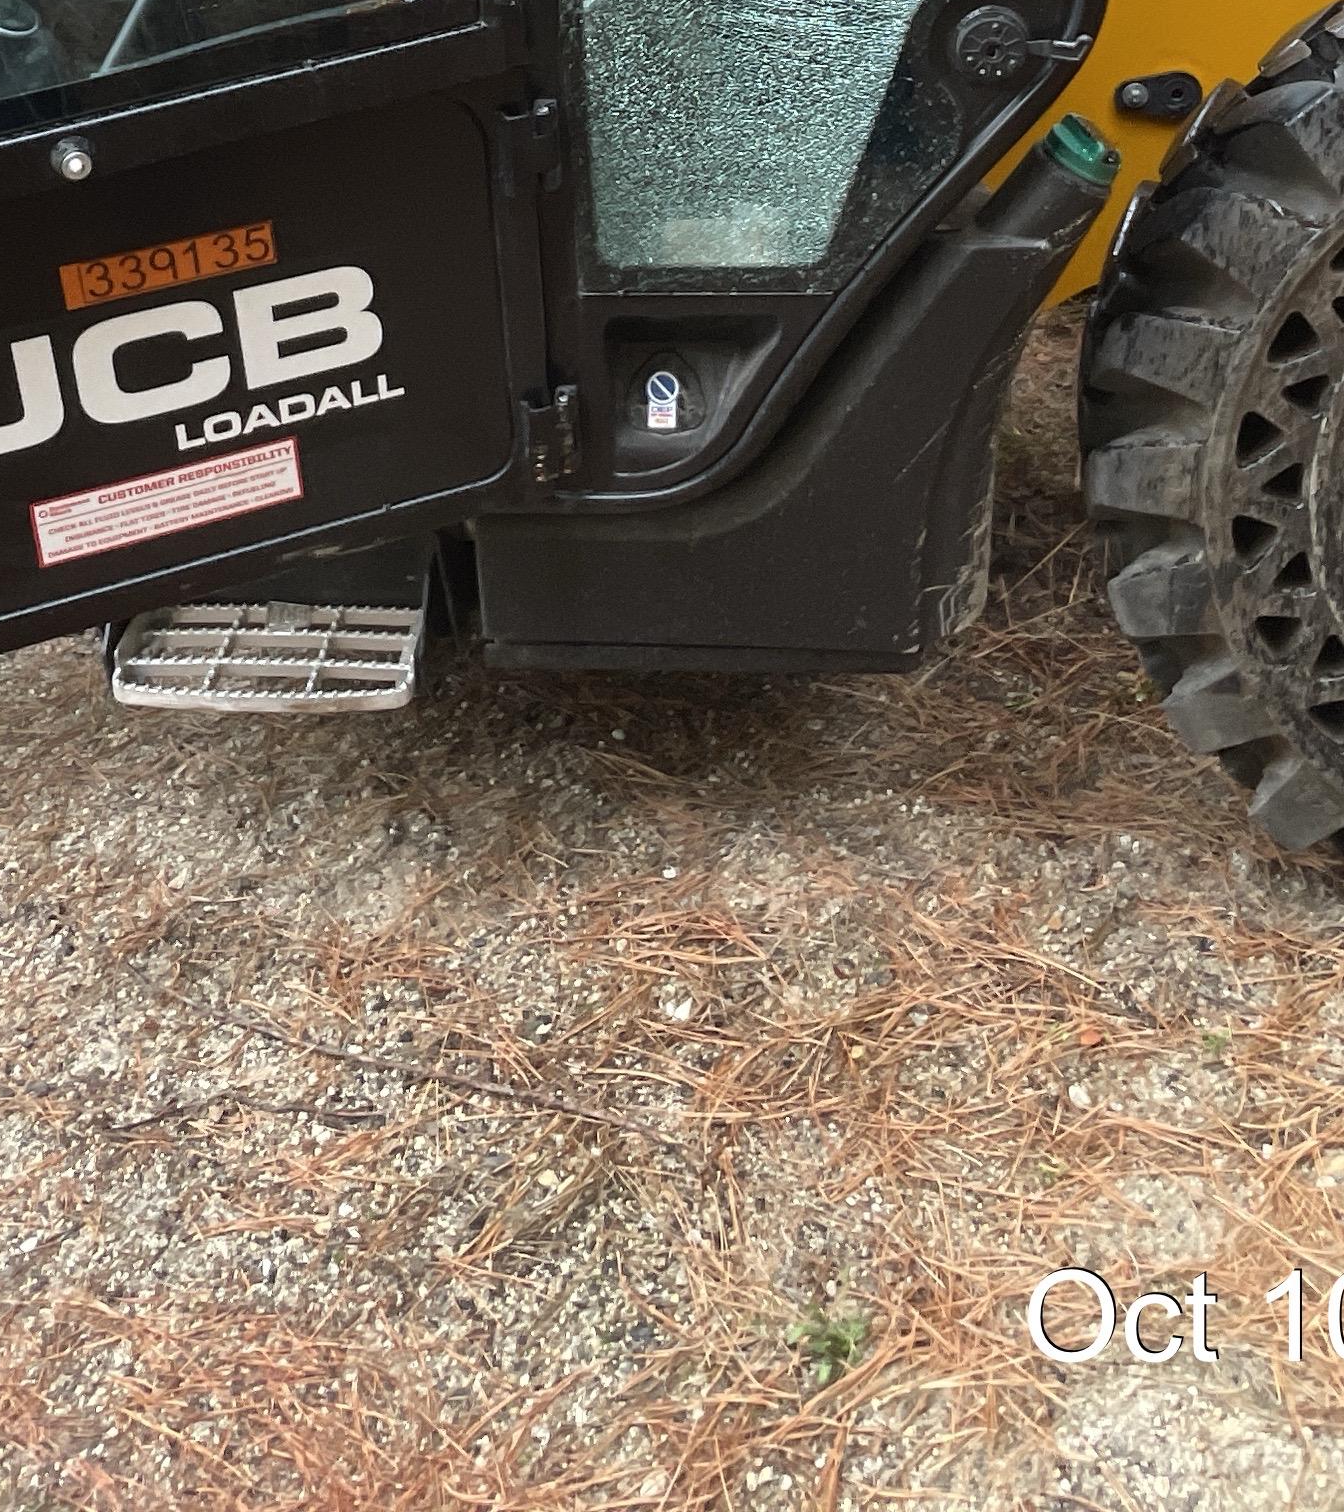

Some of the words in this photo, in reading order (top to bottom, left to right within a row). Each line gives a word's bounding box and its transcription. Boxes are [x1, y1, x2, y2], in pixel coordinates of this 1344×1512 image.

[85, 225, 270, 297] 339135
[175, 374, 405, 450] LOADALL
[97, 476, 175, 504] CUSTOMER
[177, 445, 291, 483] RESPONSIBILITY
